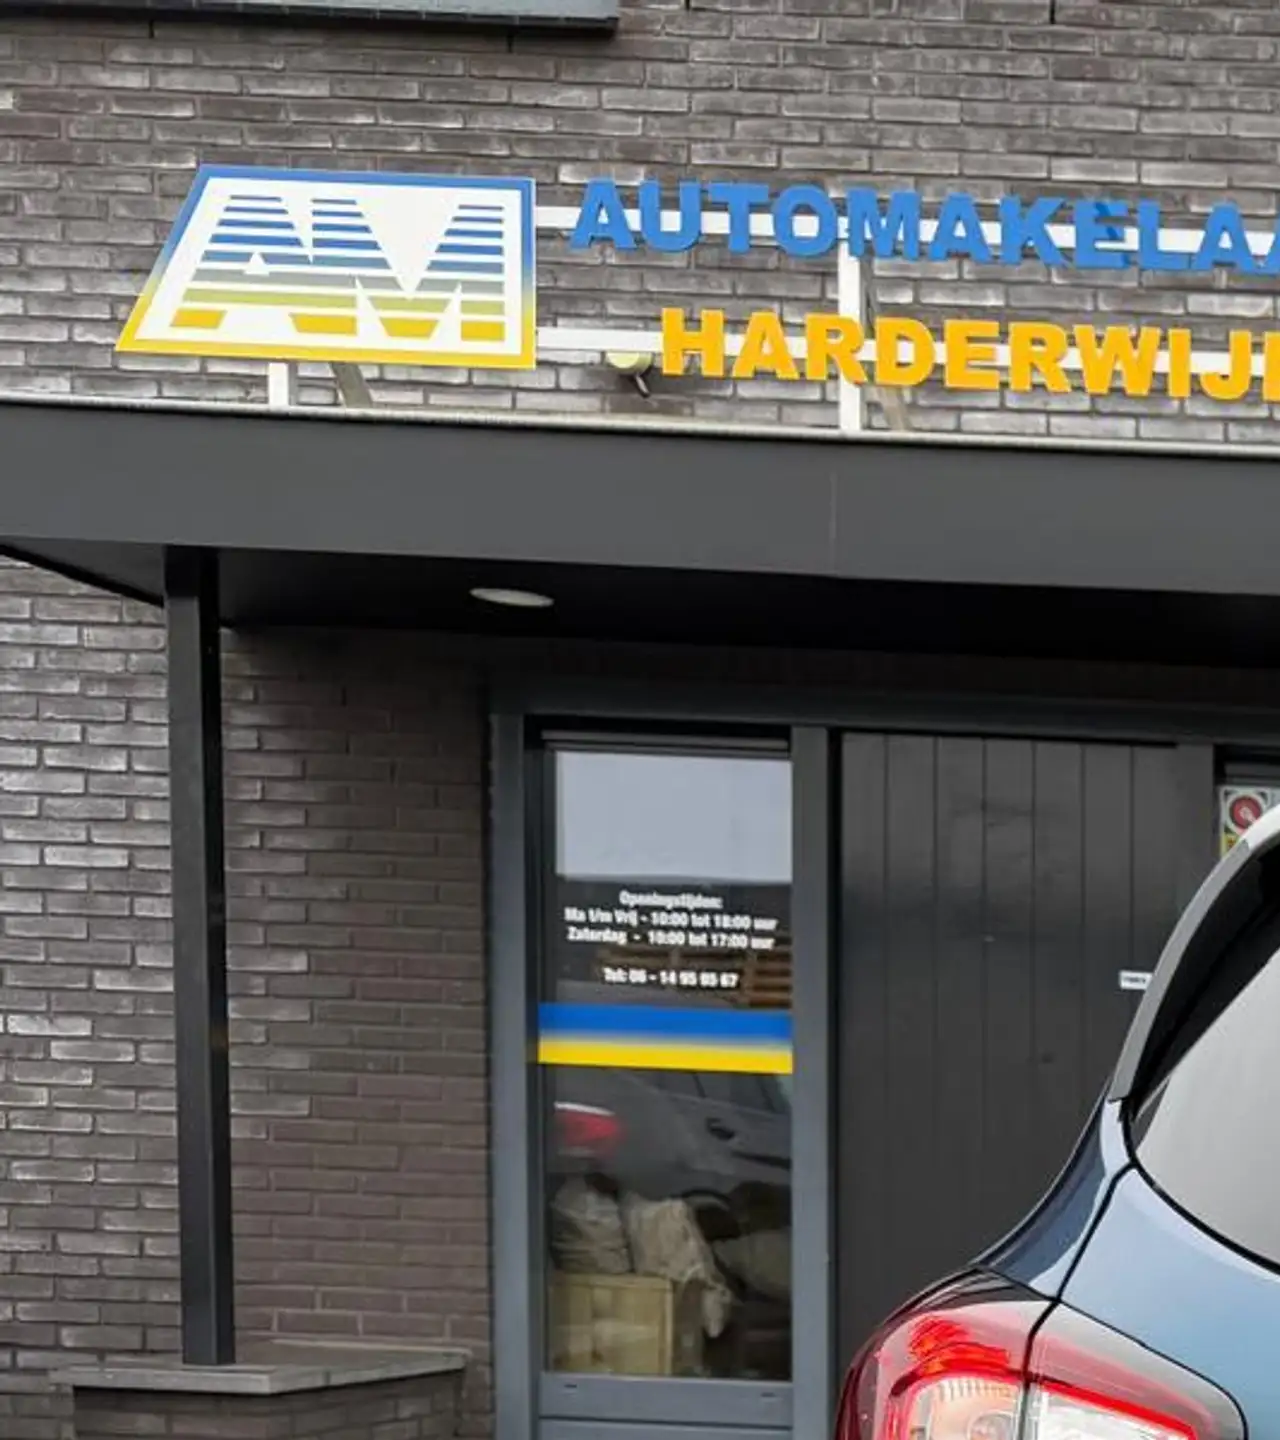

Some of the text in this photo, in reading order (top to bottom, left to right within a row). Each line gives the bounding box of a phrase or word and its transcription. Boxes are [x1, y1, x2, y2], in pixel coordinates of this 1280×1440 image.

[652, 912, 688, 927] 10:00
[691, 914, 710, 927] tot
[714, 915, 751, 929] 18:00
[568, 926, 627, 945] Zaterdag
[689, 933, 707, 946] tot
[711, 934, 748, 948] 17:00
